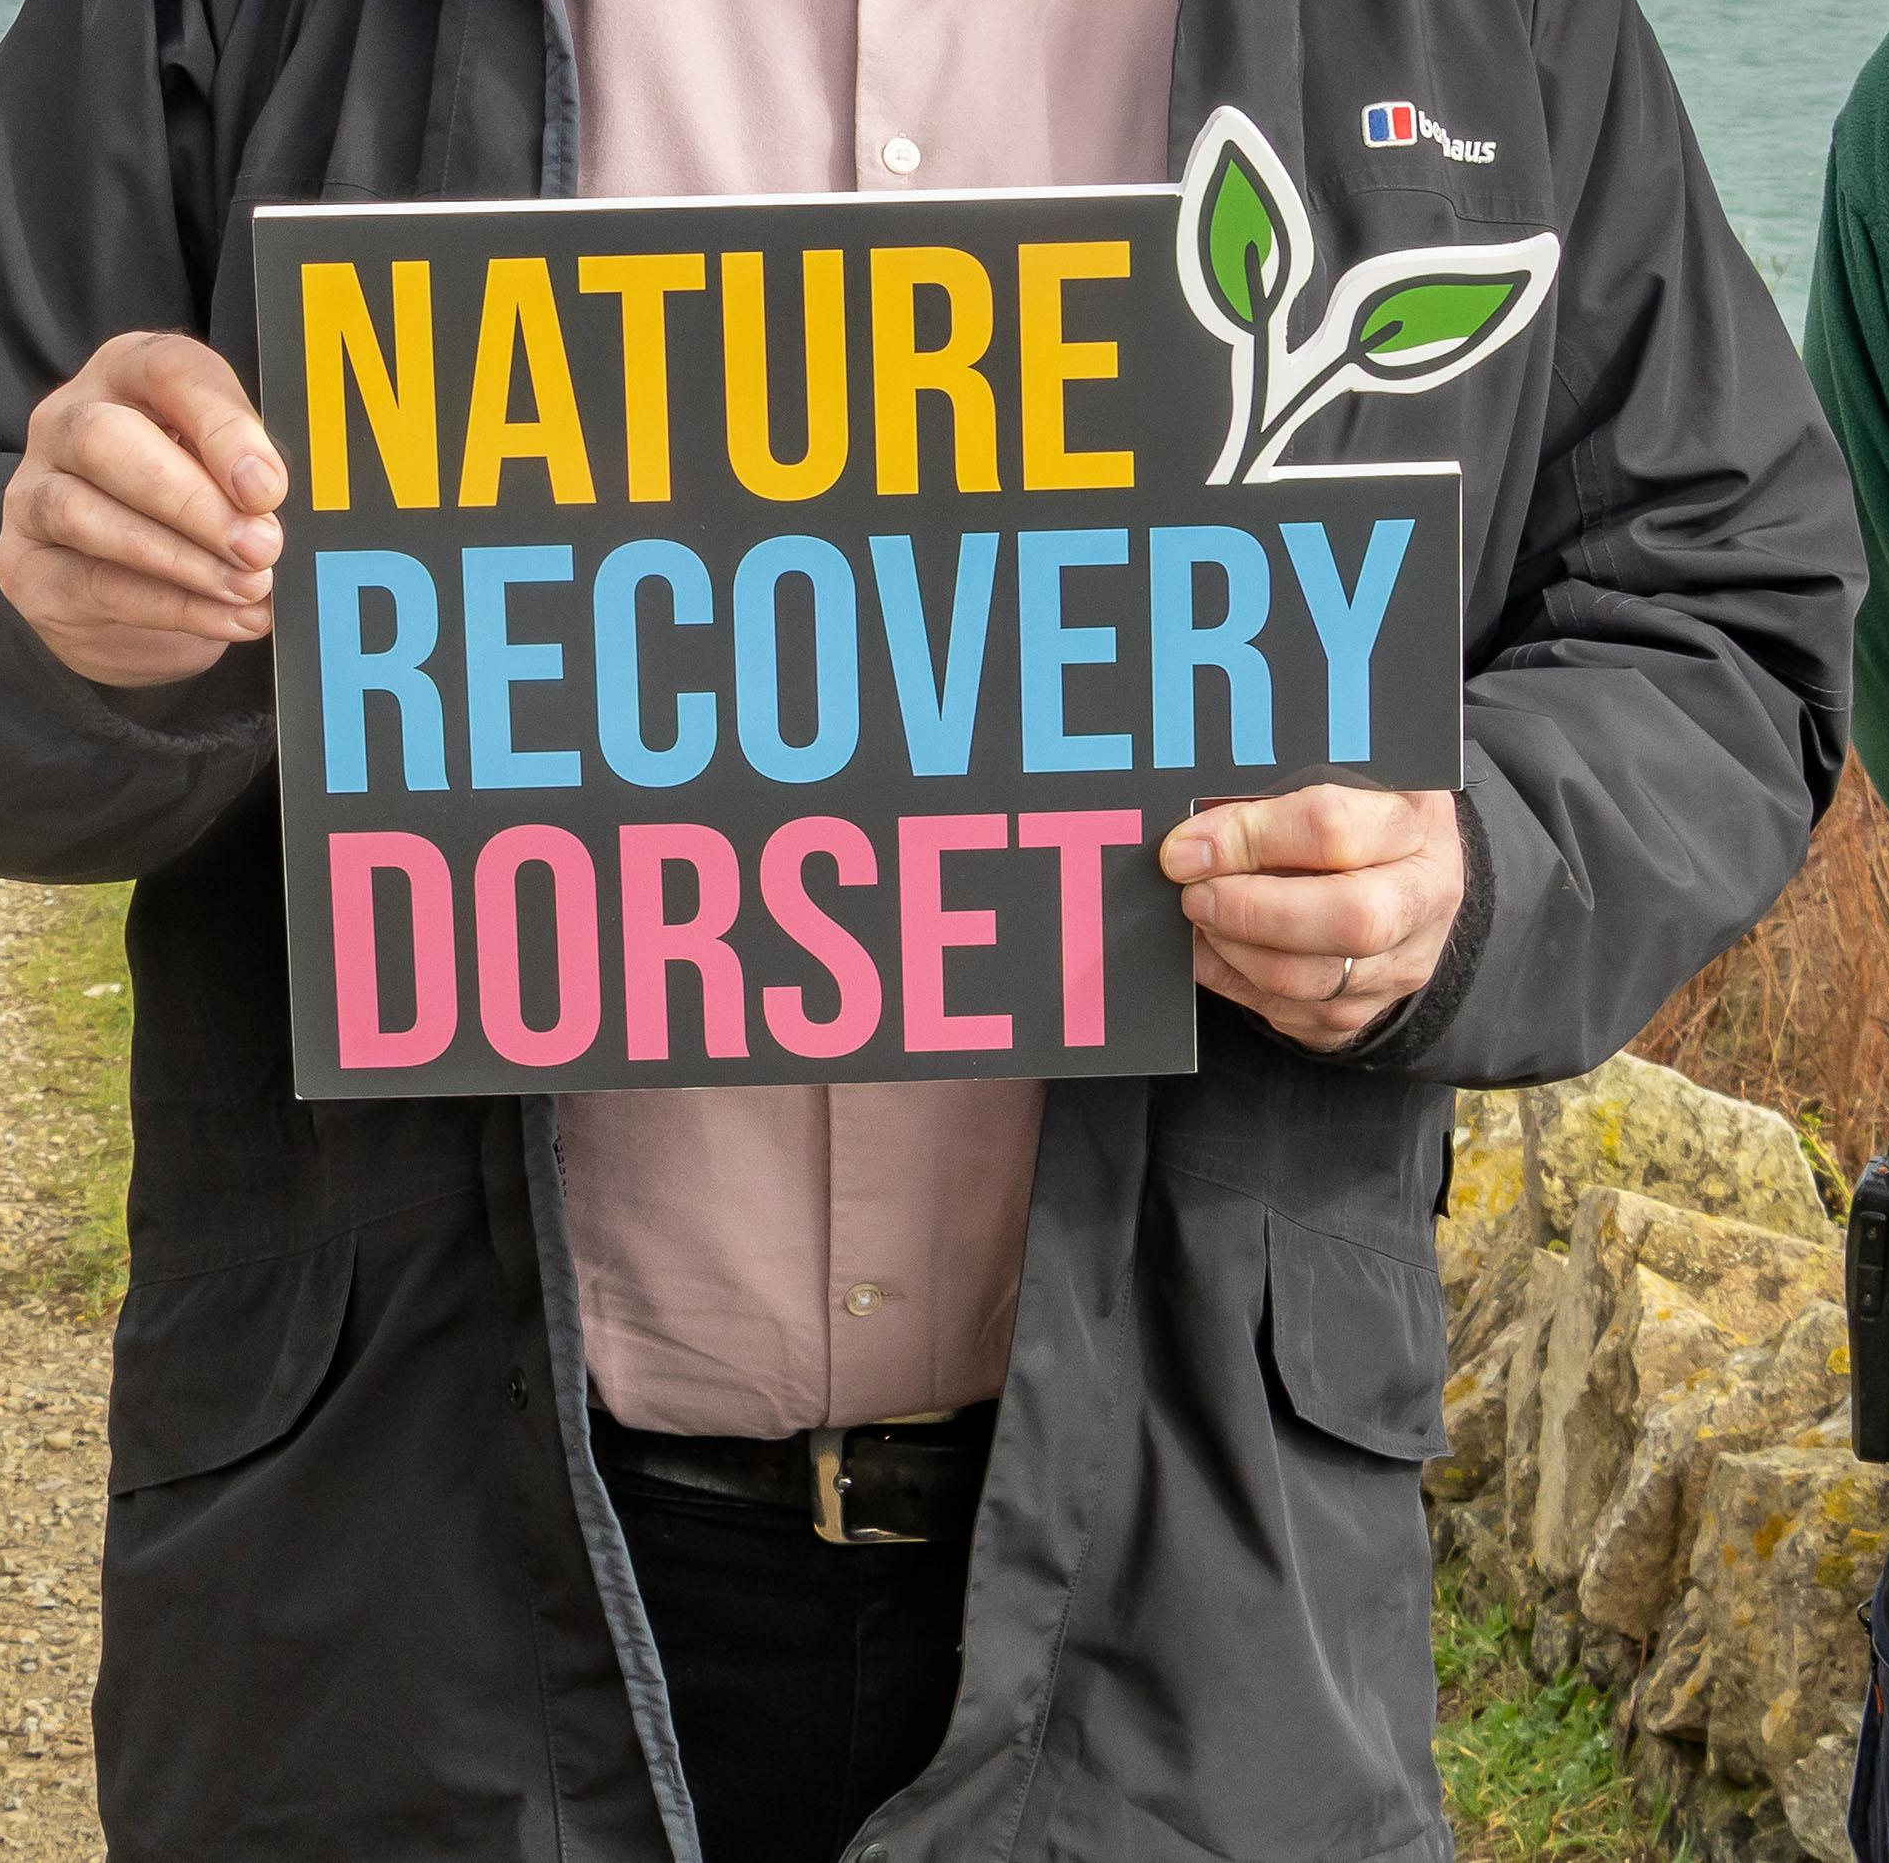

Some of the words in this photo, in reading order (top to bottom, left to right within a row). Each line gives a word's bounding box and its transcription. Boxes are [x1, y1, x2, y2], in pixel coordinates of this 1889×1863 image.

[300, 240, 1135, 512] NATURE
[314, 518, 1416, 794] RECOVERY
[327, 808, 1143, 1070] DORSET
